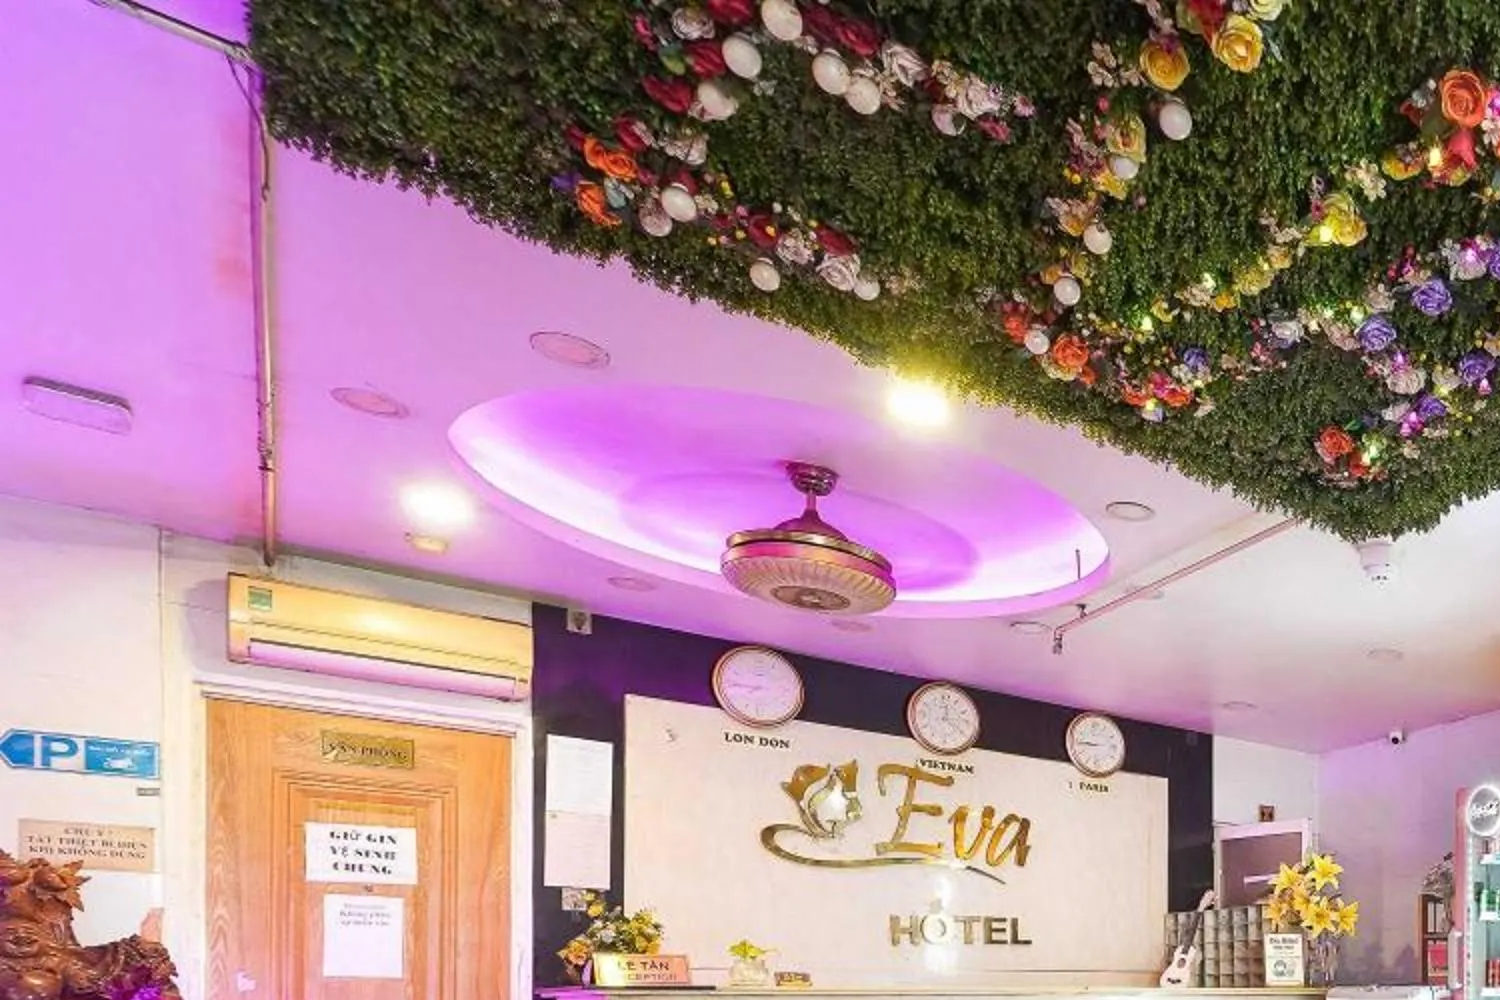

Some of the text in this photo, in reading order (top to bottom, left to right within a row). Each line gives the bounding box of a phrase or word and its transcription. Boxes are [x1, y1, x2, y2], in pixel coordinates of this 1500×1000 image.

[724, 732, 790, 748] LON DON
[875, 763, 1032, 867] Eva
